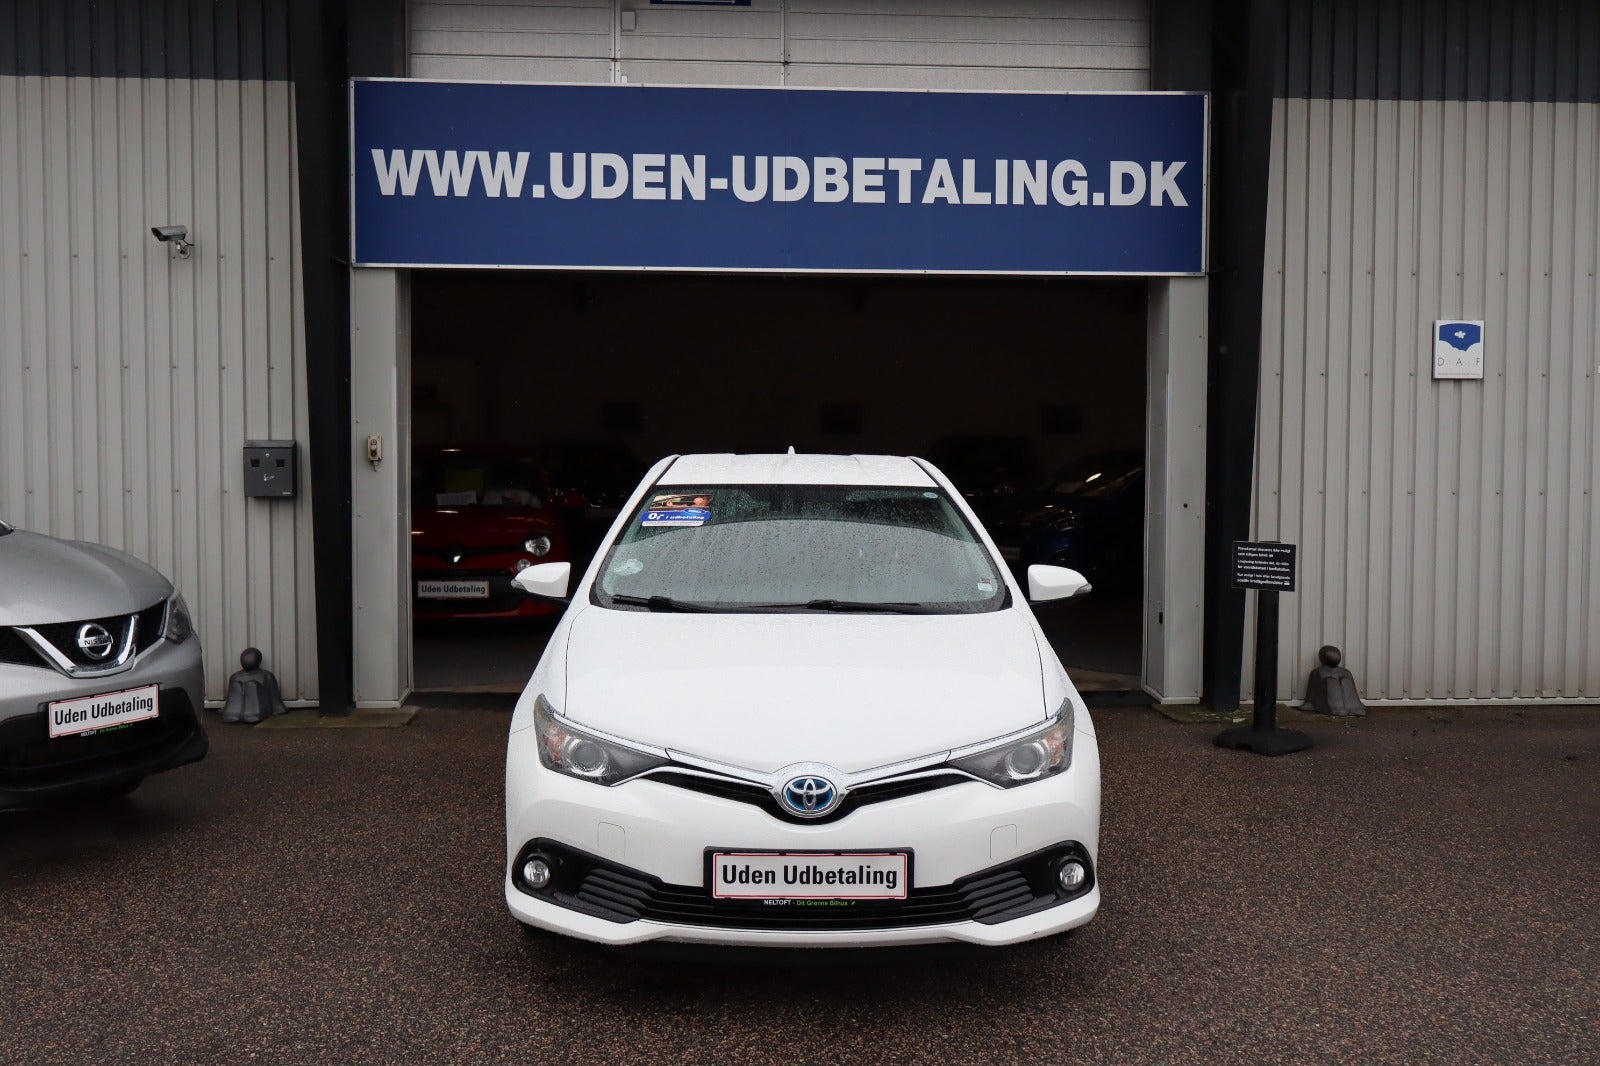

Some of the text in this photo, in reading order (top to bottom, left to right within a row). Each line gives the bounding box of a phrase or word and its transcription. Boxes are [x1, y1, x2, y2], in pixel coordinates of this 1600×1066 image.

[371, 148, 1189, 207] WWW.UDEN-UDBETALING.DK
[421, 584, 486, 595] Uden Udbetaling
[54, 696, 153, 726] Uden Udbetaling
[722, 864, 898, 889] Uden Udbetaling
